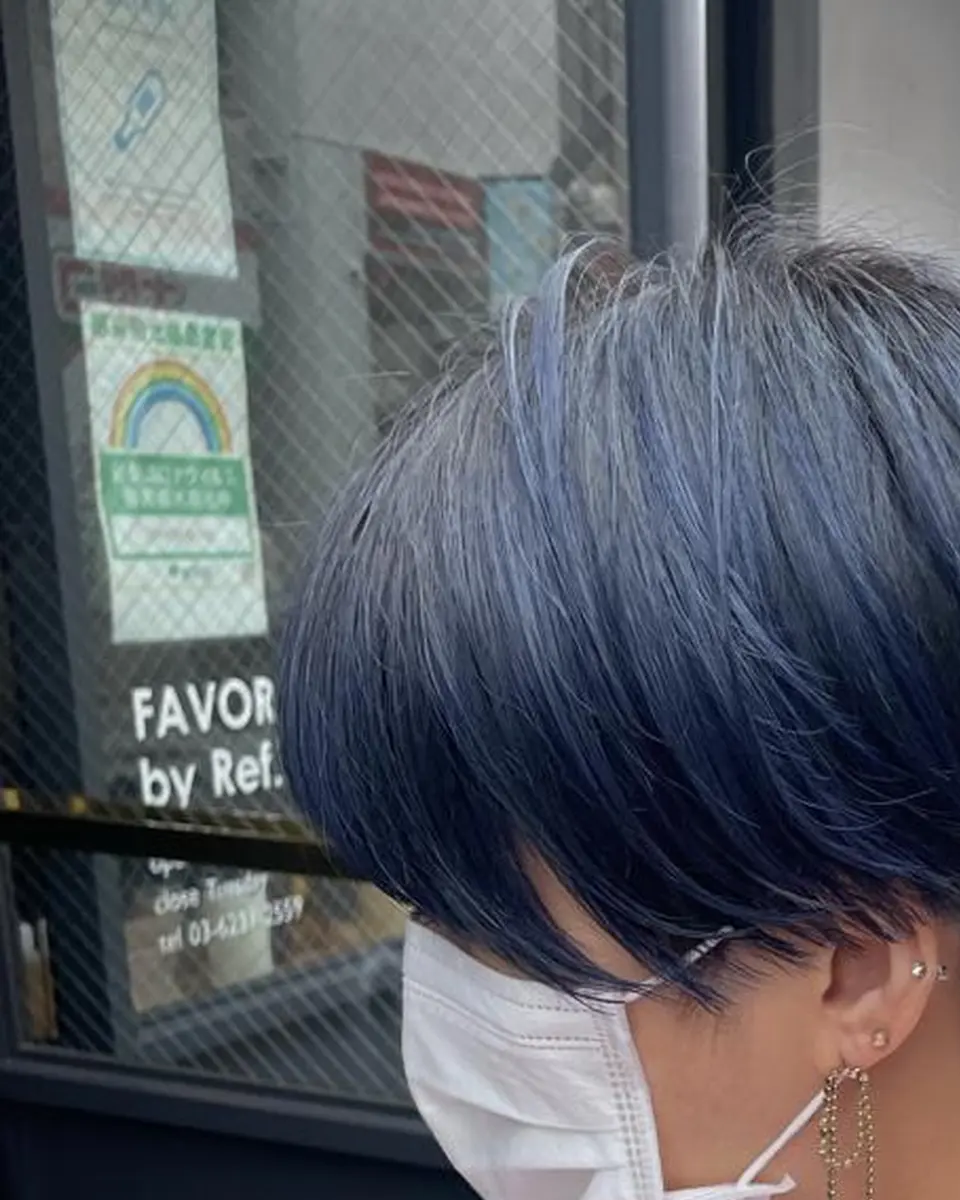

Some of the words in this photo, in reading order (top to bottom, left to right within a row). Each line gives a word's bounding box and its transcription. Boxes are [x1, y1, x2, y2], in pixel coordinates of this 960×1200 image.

[132, 674, 275, 742] FAVOR
[139, 756, 197, 809] by
[211, 739, 283, 797] Ref.
